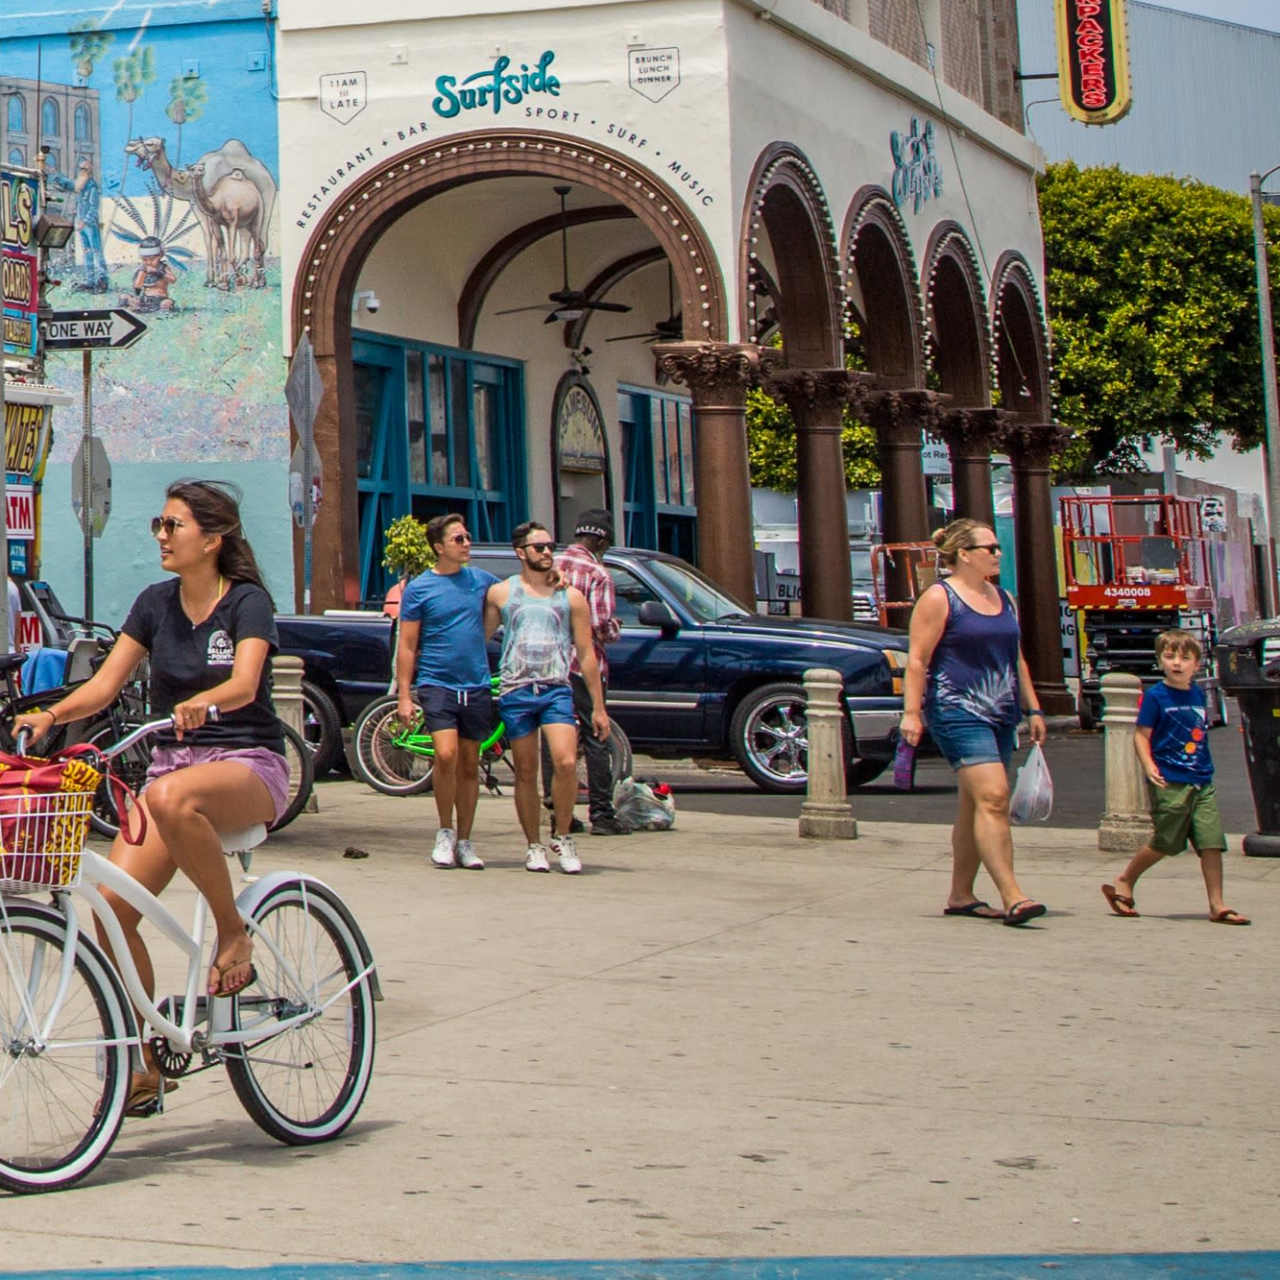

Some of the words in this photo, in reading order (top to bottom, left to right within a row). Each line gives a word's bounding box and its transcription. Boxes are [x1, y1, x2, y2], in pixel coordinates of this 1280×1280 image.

[635, 53, 673, 64] BRUNCH
[329, 98, 360, 110] LATE
[432, 50, 560, 118] Surfside
[296, 146, 374, 229] RESTAURANT
[397, 121, 429, 141] BAR
[525, 106, 579, 124] SPORT
[606, 122, 648, 150] SURF
[667, 161, 714, 207] MUSIC
[49, 323, 78, 338] ONE
[83, 321, 114, 337] WAY
